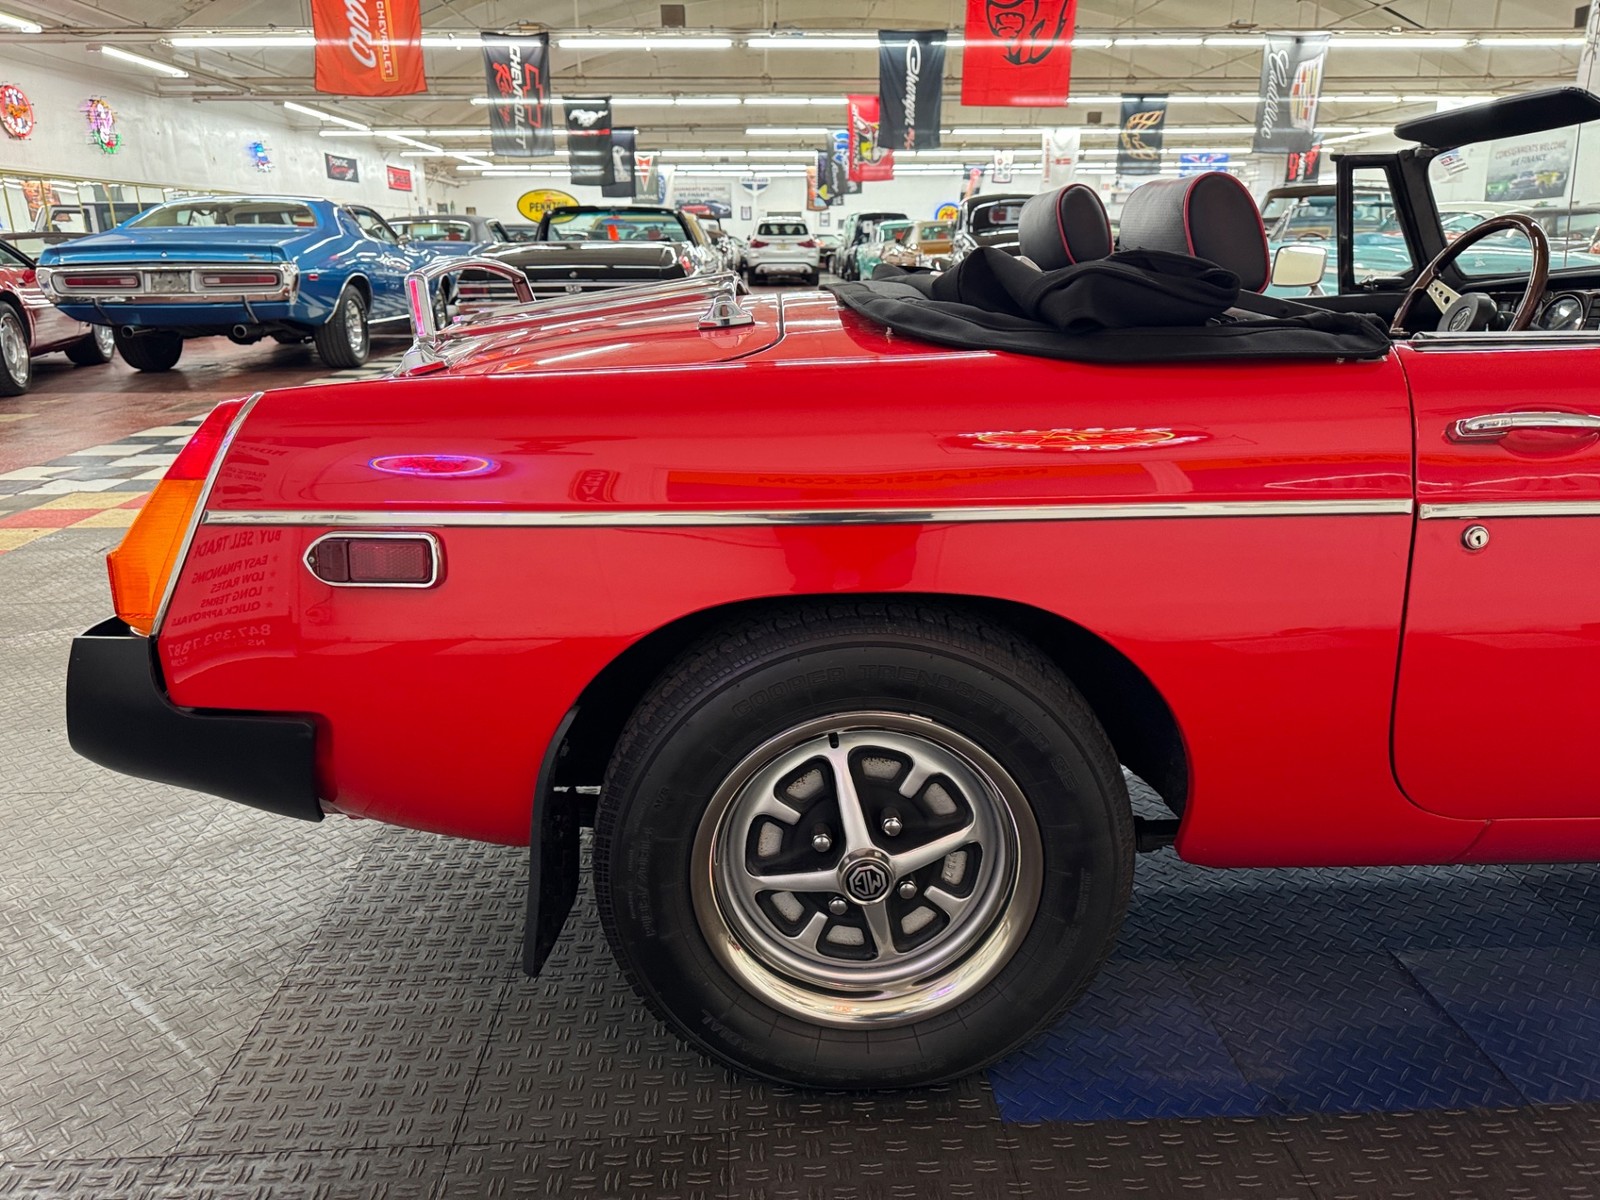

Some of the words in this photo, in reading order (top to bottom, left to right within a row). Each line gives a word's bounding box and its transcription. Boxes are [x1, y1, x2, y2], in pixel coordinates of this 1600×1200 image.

[375, 1, 394, 76] CHEVROLET
[508, 45, 526, 149] CHEVROLET
[901, 39, 921, 126] Charger
[1260, 49, 1289, 139] Cadillac
[529, 200, 568, 213] PENNZ
[732, 666, 847, 718] COOPER
[857, 664, 1050, 752] TRENDSETTER
[853, 869, 883, 897] MG
